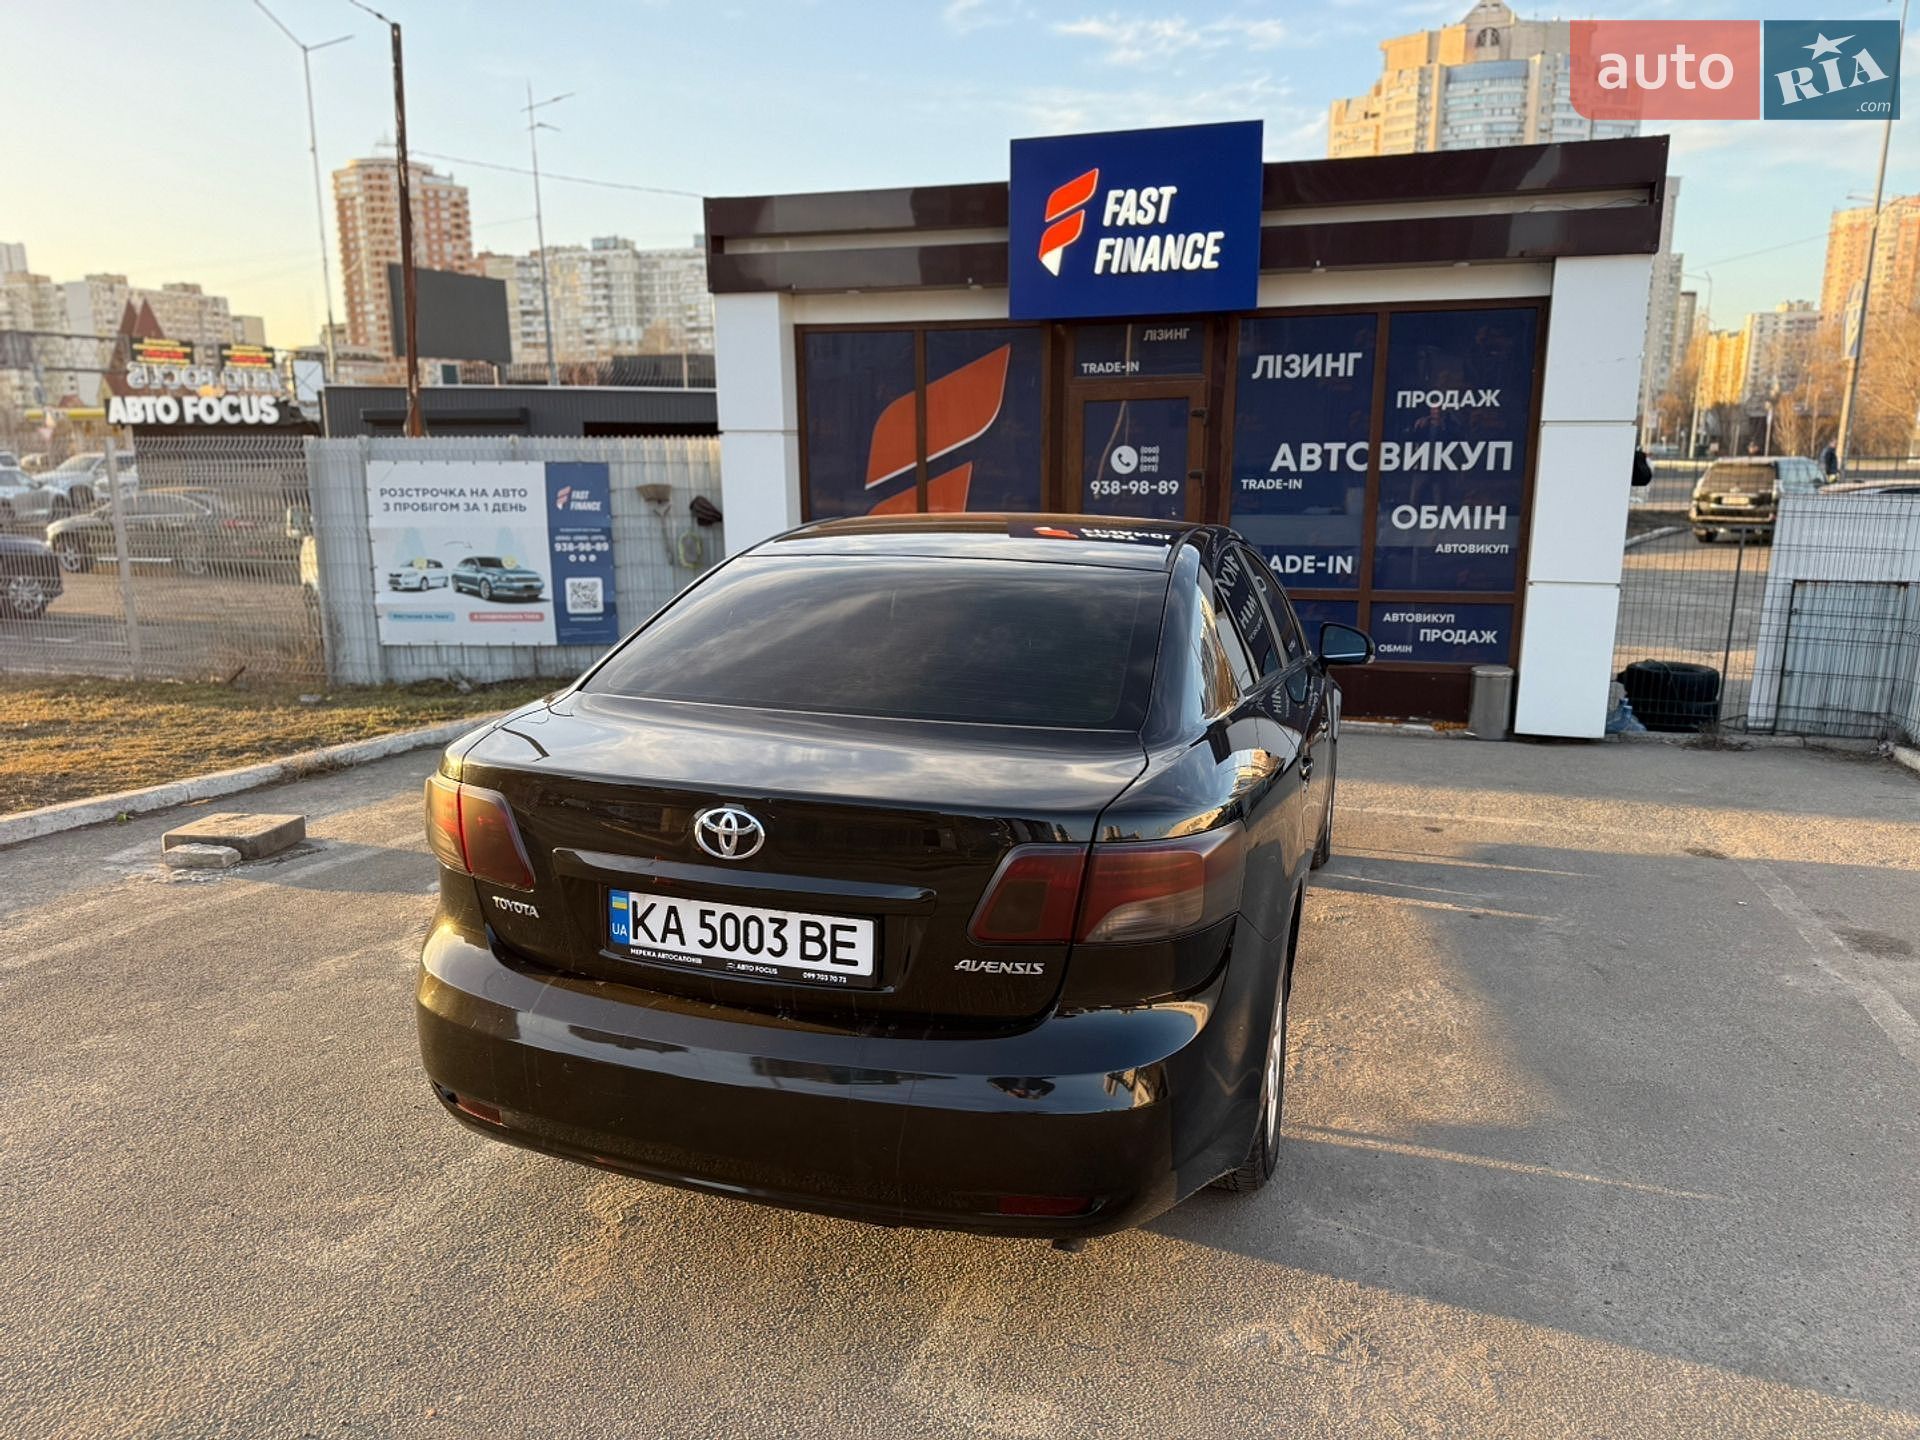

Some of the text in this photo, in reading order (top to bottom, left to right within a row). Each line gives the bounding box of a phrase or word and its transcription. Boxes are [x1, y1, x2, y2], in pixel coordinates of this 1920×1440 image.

[1103, 186, 1178, 227] FAST
[1094, 231, 1225, 275] FINANCE
[1143, 328, 1190, 341] ЛІЗИНГ
[1081, 361, 1140, 375] TRADE-IN
[1252, 352, 1363, 380] ЛІЗИНГ
[1396, 388, 1501, 411] ПРОДАЖ
[108, 394, 280, 425] АВТО FOCUS
[1090, 480, 1179, 496] 938-98-89
[1241, 478, 1303, 490] TRADE-IN
[379, 487, 529, 498] РОЗСТРОЧКА НА АВТО
[571, 490, 590, 500] FAST
[393, 502, 460, 512] ПРОБІГОМ
[463, 502, 481, 512] ЗА
[484, 502, 489, 512] 1
[491, 502, 528, 514] ДЕНЬ
[569, 501, 602, 512] FINANCE
[1391, 505, 1508, 531] ОБМІН
[1435, 543, 1509, 555] АВТОВИКУП
[1383, 612, 1455, 624] АВТОВИКУП
[1419, 628, 1499, 645] ПРОДАЖ
[1378, 643, 1413, 654] ОБМІН
[492, 896, 540, 919] TOYOTA
[612, 922, 628, 937] UA
[631, 900, 859, 967] KA 5003 BE
[755, 965, 779, 976] FOCUS
[953, 959, 1046, 975] AVENSIS
